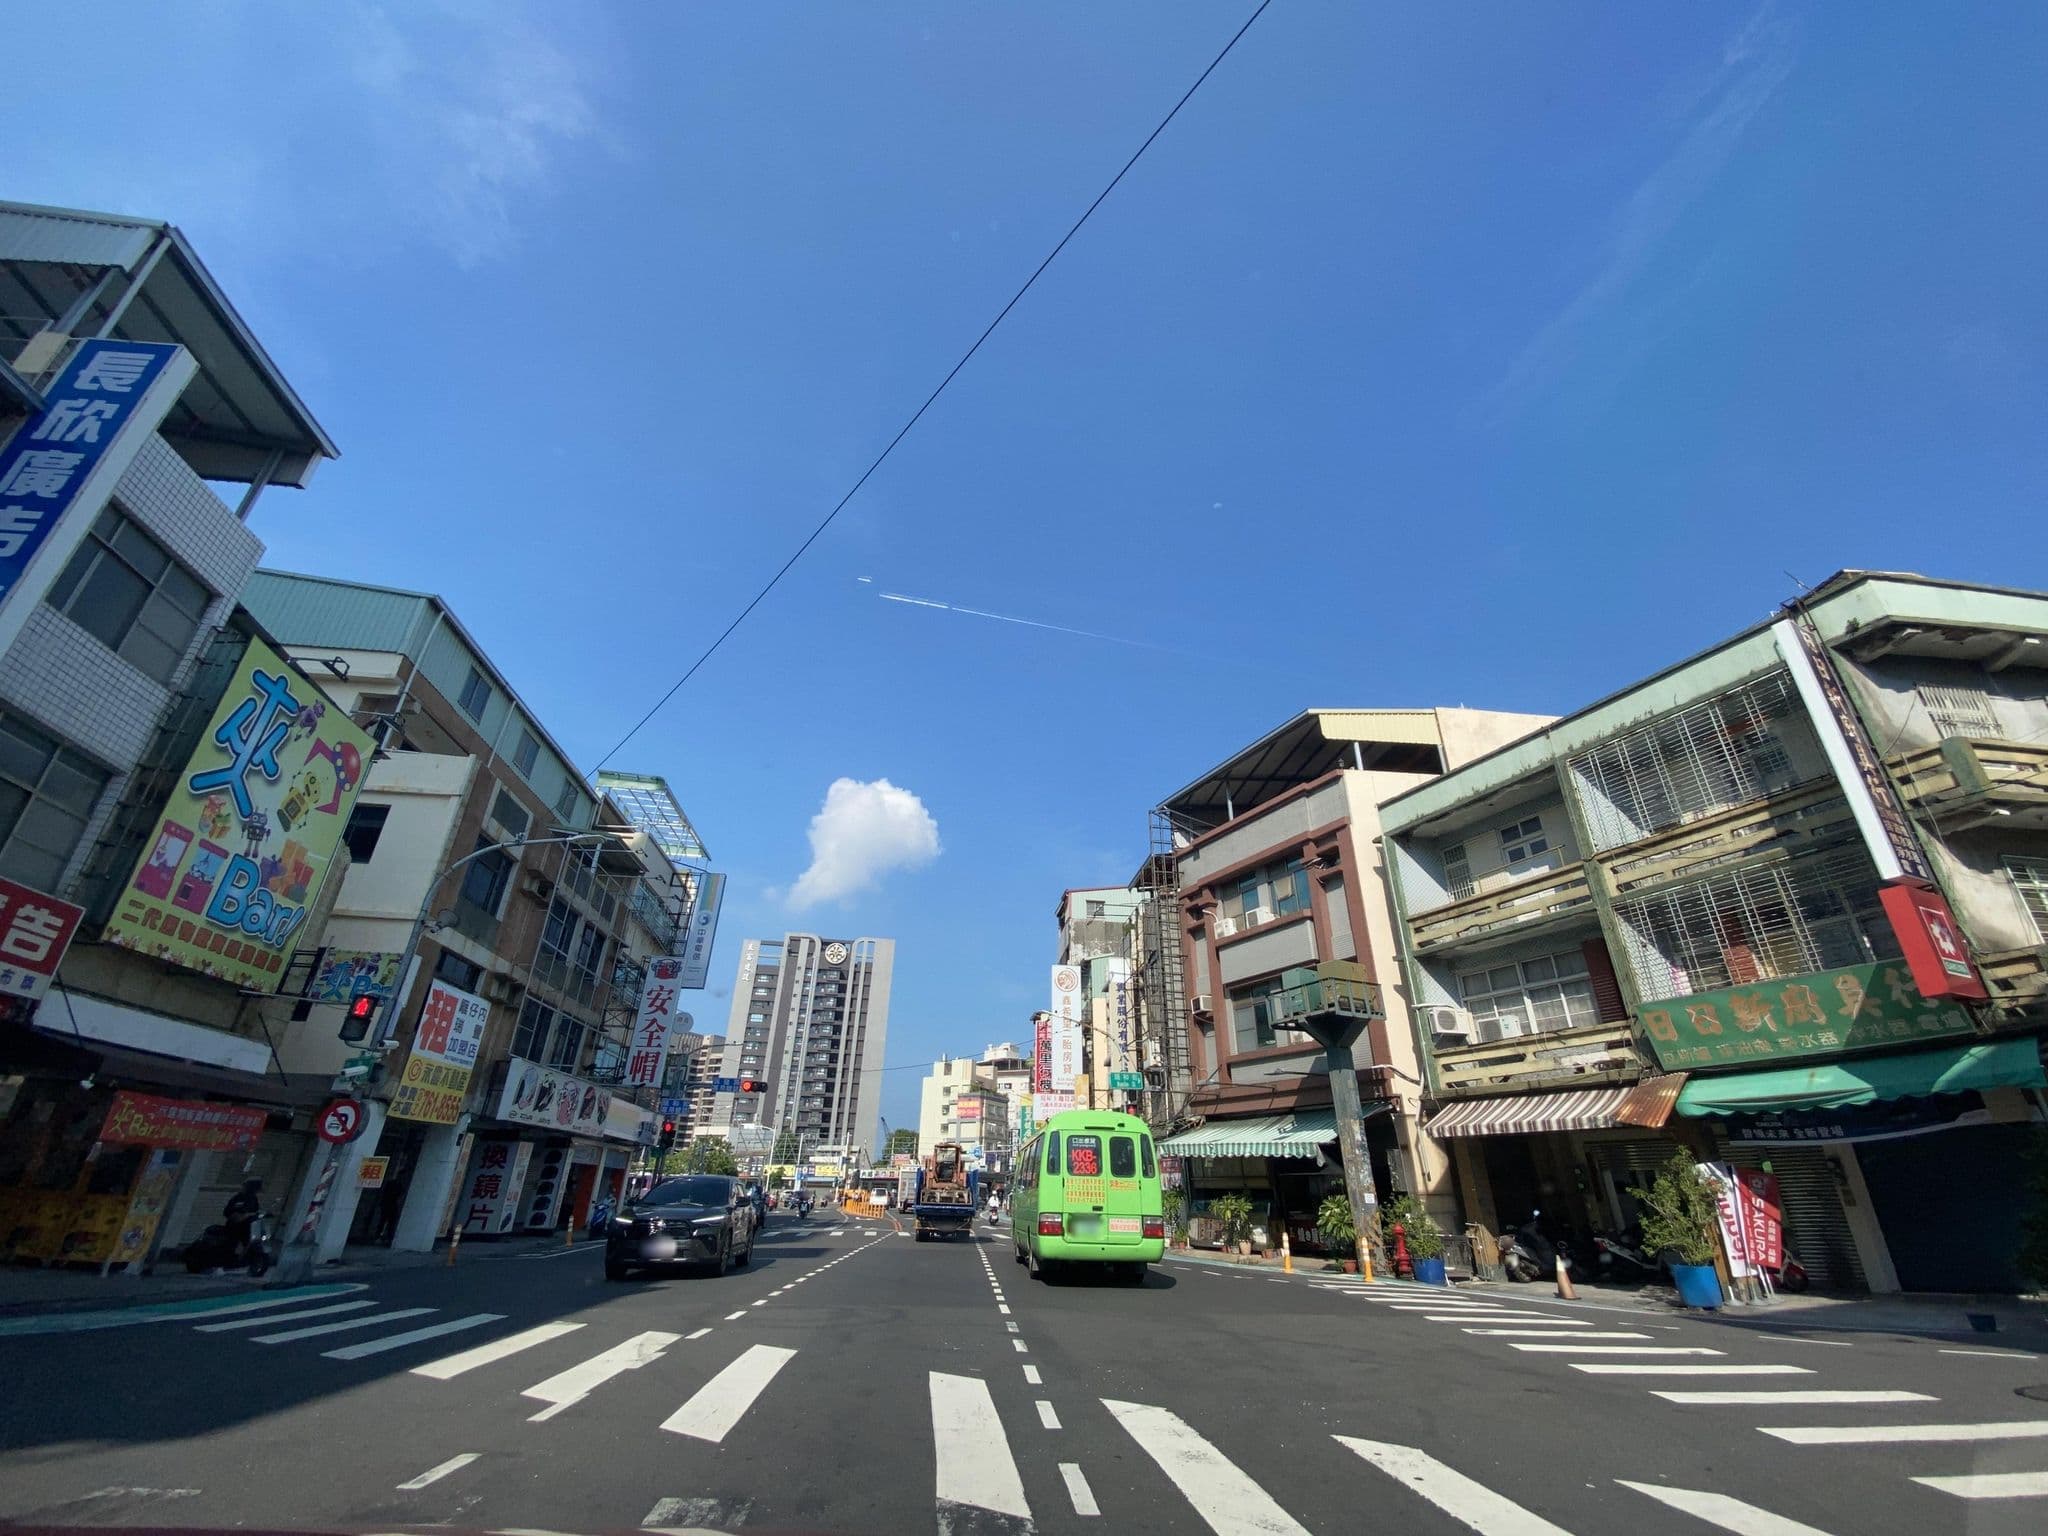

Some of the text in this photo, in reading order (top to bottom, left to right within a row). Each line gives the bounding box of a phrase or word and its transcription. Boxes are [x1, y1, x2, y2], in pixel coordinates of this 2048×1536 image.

[189, 667, 301, 820] 夾
[0, 895, 64, 962] 告
[629, 984, 674, 1084] 安全帽
[1751, 1196, 1768, 1261] SAKURA
